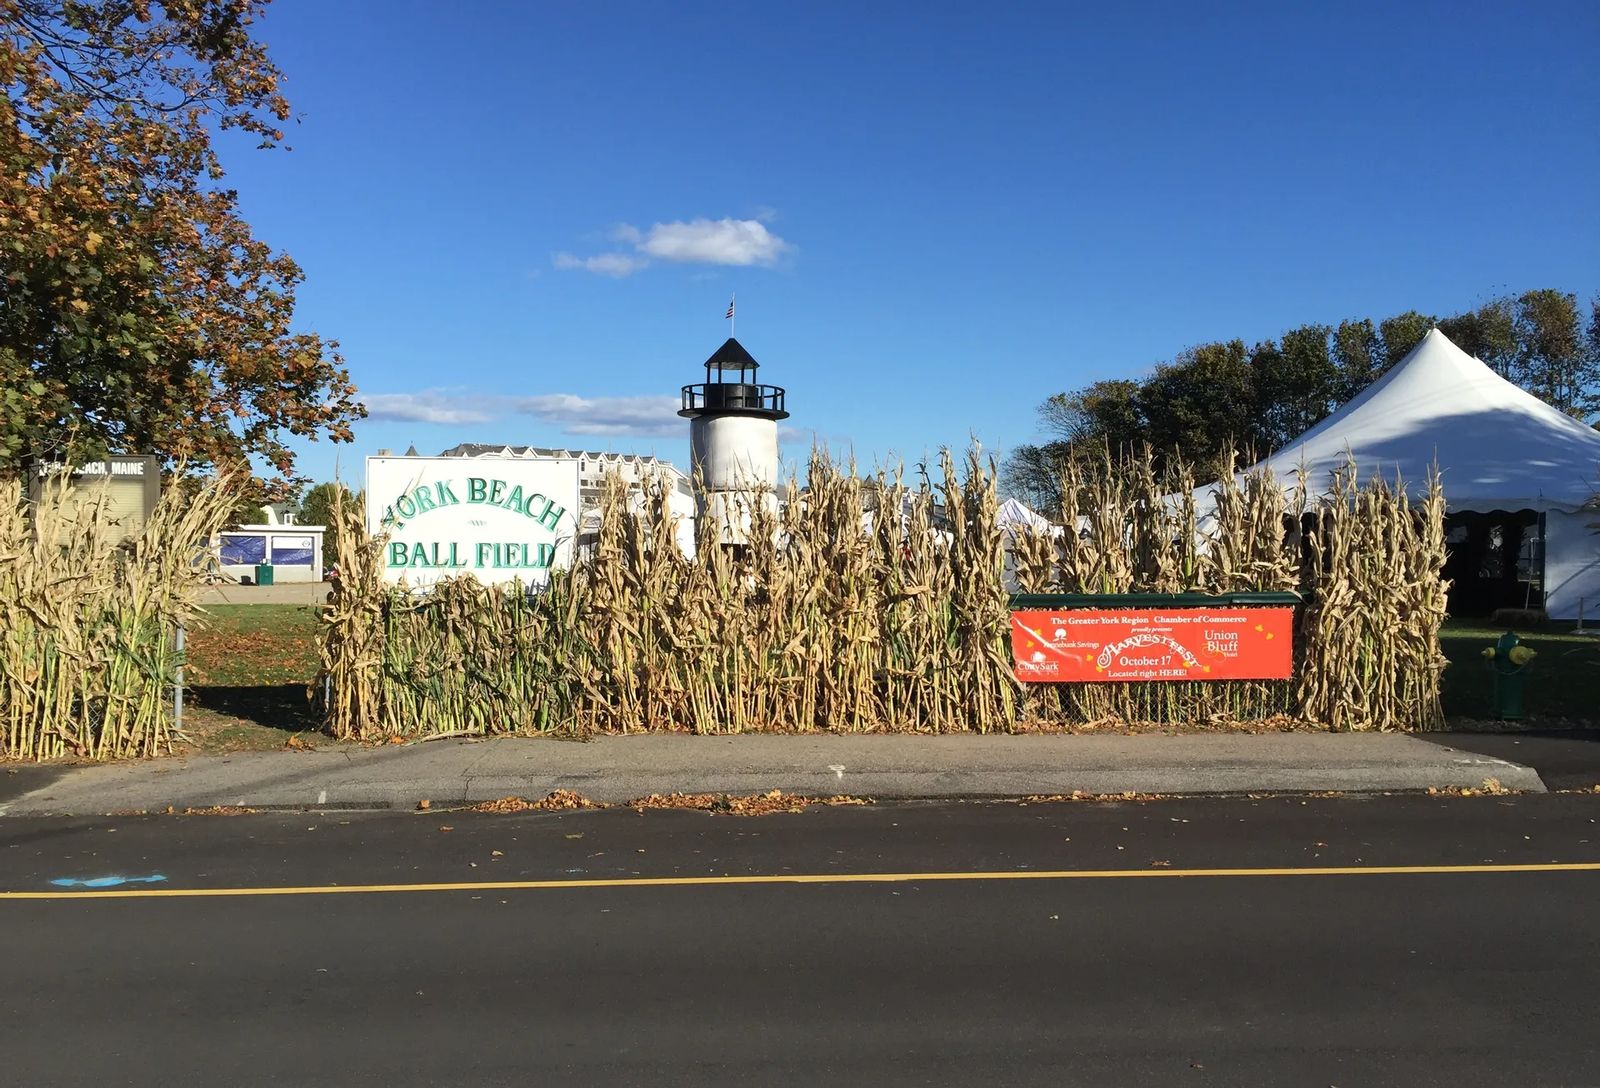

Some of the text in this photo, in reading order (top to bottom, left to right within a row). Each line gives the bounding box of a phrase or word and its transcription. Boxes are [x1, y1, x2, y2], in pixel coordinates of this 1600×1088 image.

[111, 461, 144, 475] MAINE
[466, 477, 566, 532] BEACH
[387, 542, 556, 569] BALL FIELD
[1050, 615, 1247, 626] The Greater York Region Chamber of Commerce
[1204, 629, 1238, 640] Union
[1077, 641, 1100, 649] Savings
[1207, 640, 1238, 652] Bluff
[1119, 655, 1172, 666] October 17
[1139, 669, 1157, 679] right
[1159, 669, 1187, 677] HERE!
